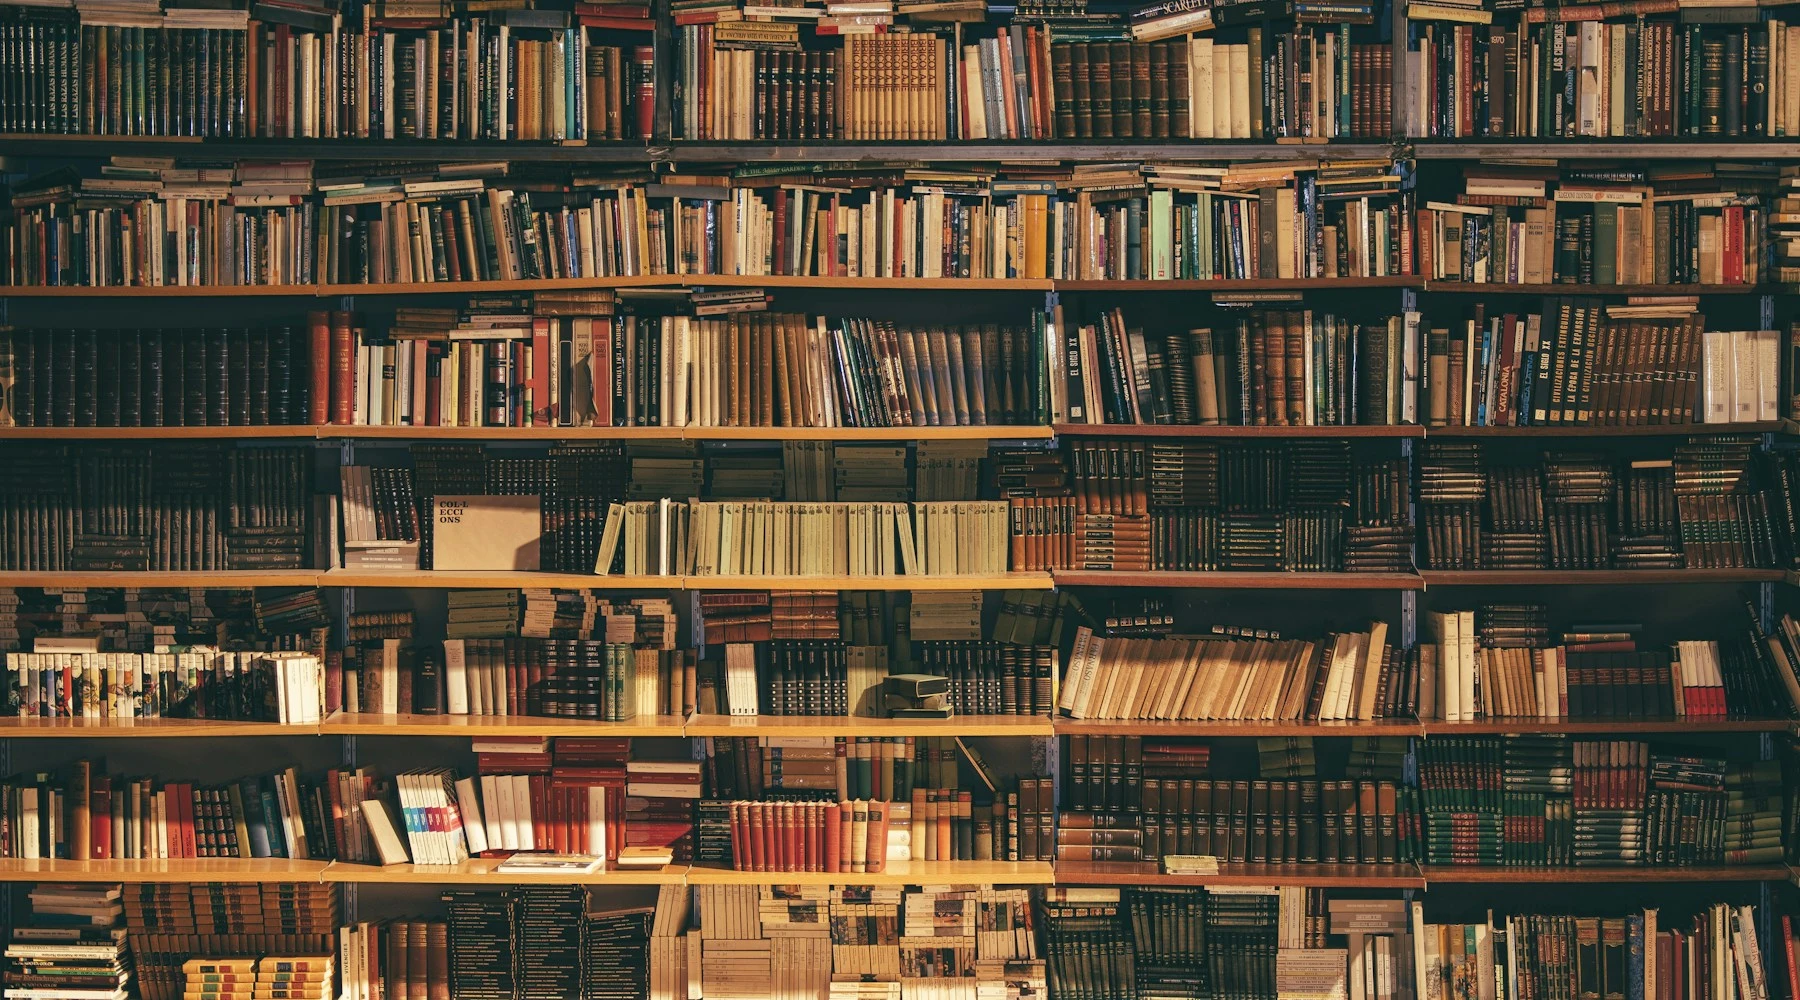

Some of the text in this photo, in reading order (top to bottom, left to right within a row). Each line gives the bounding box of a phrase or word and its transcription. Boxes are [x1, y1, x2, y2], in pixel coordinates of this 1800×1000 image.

[1553, 24, 1564, 71] LAS CIENCIAS
[1647, 61, 1653, 70] DE
[962, 244, 970, 255] 45
[1573, 308, 1584, 345] EXPANSIÓN
[1587, 307, 1599, 347] OCCIDENTAL
[1650, 327, 1658, 343] FAUNA
[1672, 327, 1680, 343] FAUNA
[1069, 338, 1077, 346] XX
[1608, 328, 1616, 345] FAUNA
[1660, 327, 1668, 344] FAUNA
[1541, 341, 1551, 350] XX
[1552, 305, 1570, 403] CIVILIZACIONES EXTINGUIDAS
[1069, 351, 1078, 366] SIGLO
[1540, 353, 1549, 369] SIGLO
[1571, 360, 1579, 368] DE
[1582, 350, 1593, 392] CIVILIZACIÓN
[1498, 366, 1510, 412] CATALONIA
[1567, 372, 1578, 392] ÉPOCA
[1072, 633, 1088, 671] PARNASO
[1084, 643, 1099, 681] PARNASO
